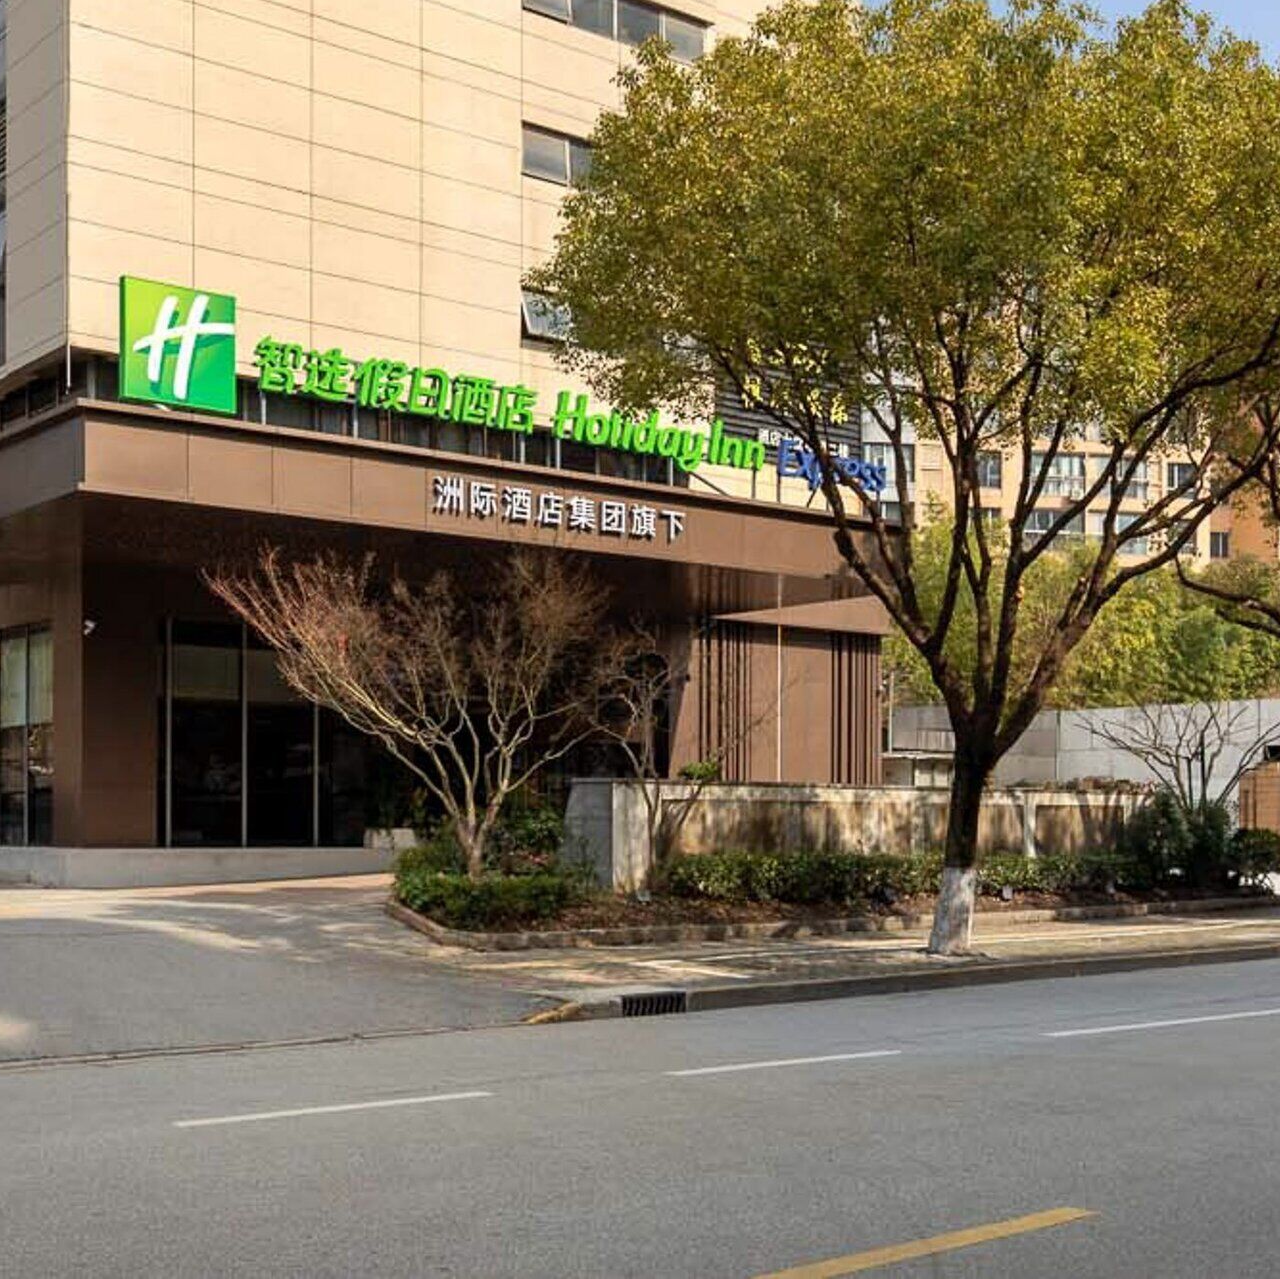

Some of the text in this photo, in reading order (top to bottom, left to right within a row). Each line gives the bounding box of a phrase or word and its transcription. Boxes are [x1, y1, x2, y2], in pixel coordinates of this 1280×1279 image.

[253, 335, 537, 434] 智选假日酒店
[552, 390, 705, 471] Holiday
[707, 417, 765, 470] Inn
[434, 476, 686, 541] 洲际酒店集团旗下
